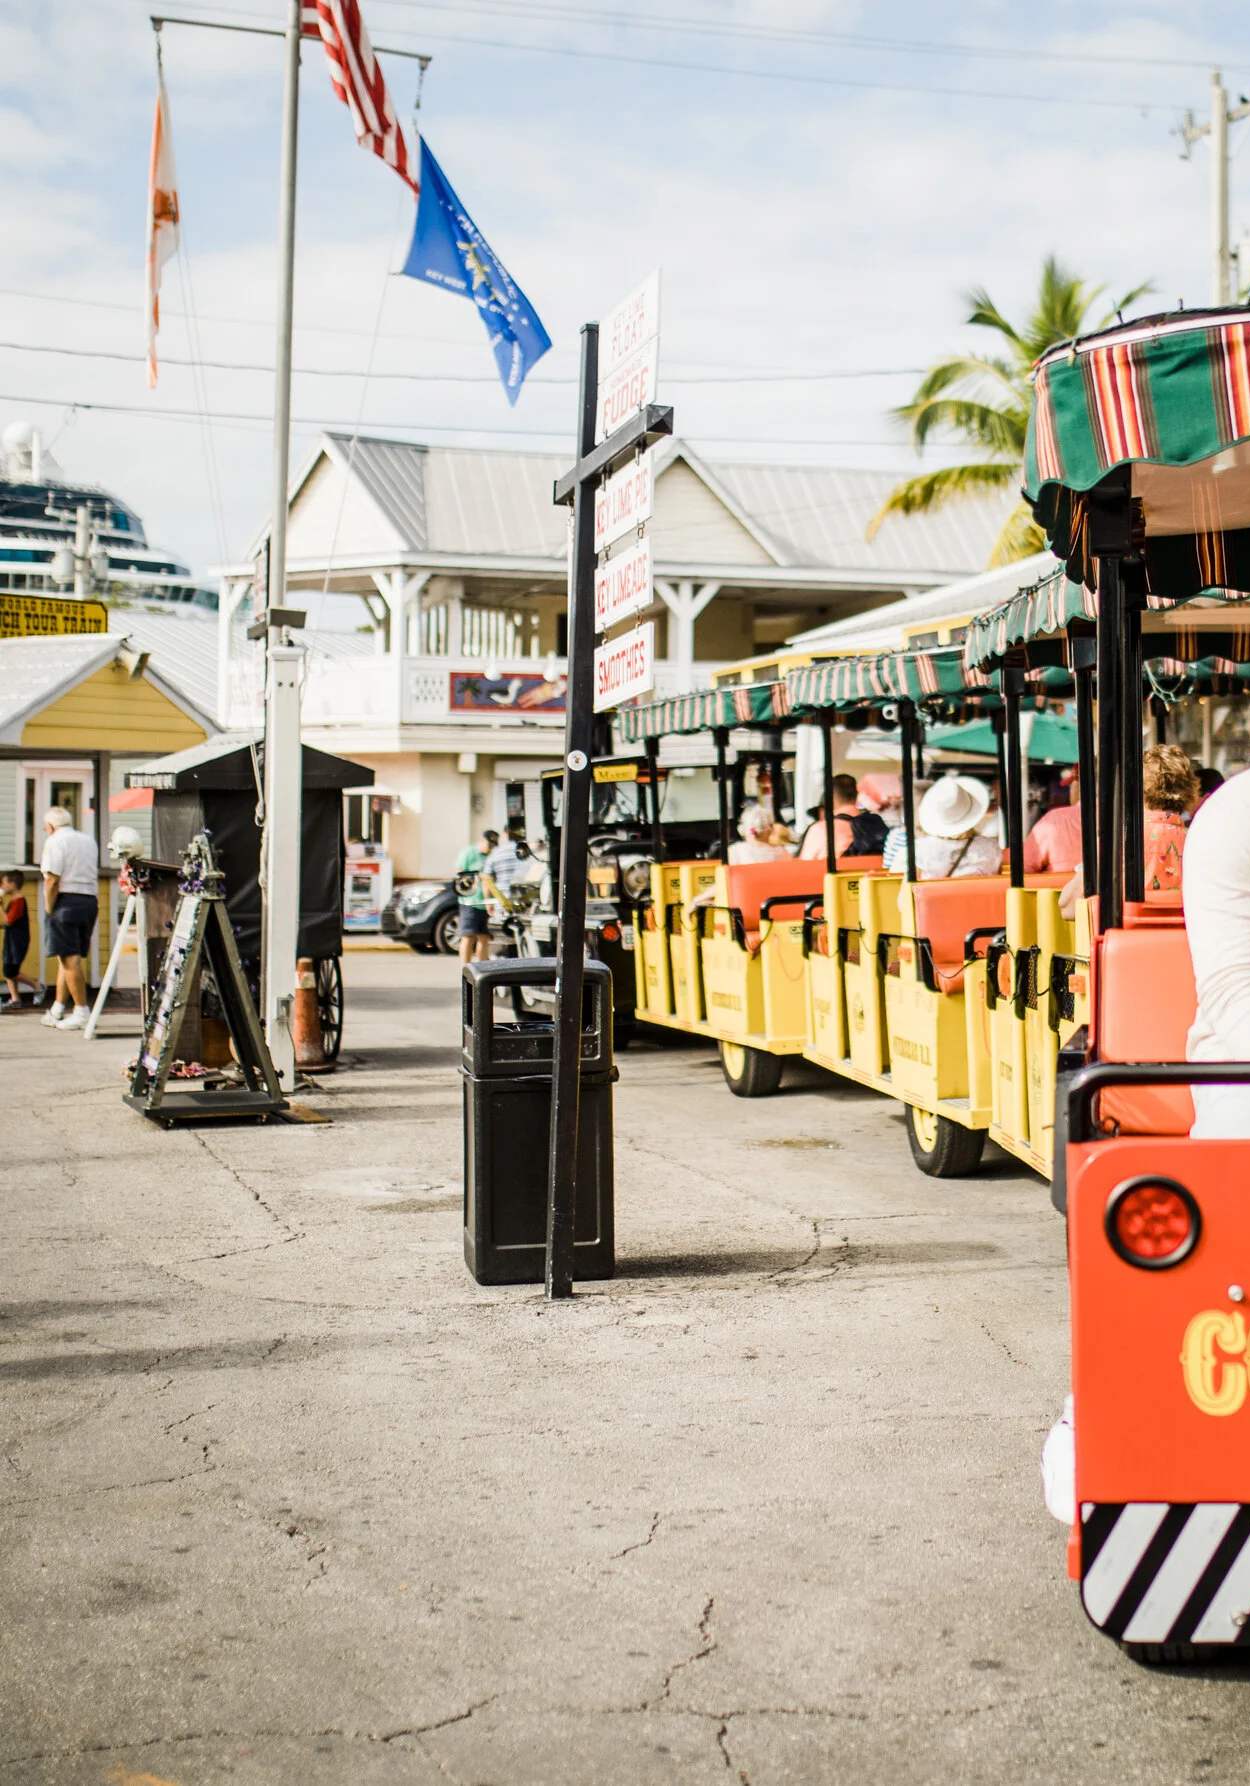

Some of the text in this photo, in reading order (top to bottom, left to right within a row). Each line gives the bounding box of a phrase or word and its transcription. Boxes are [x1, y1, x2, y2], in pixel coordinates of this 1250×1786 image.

[602, 366, 649, 433] FUDGE
[596, 467, 648, 538] KEY LIME PIE
[596, 553, 648, 618] KEY LIMEADE
[24, 613, 58, 632] TOUR
[63, 616, 102, 634] TRAIN
[598, 640, 645, 696] SMOOTHIES
